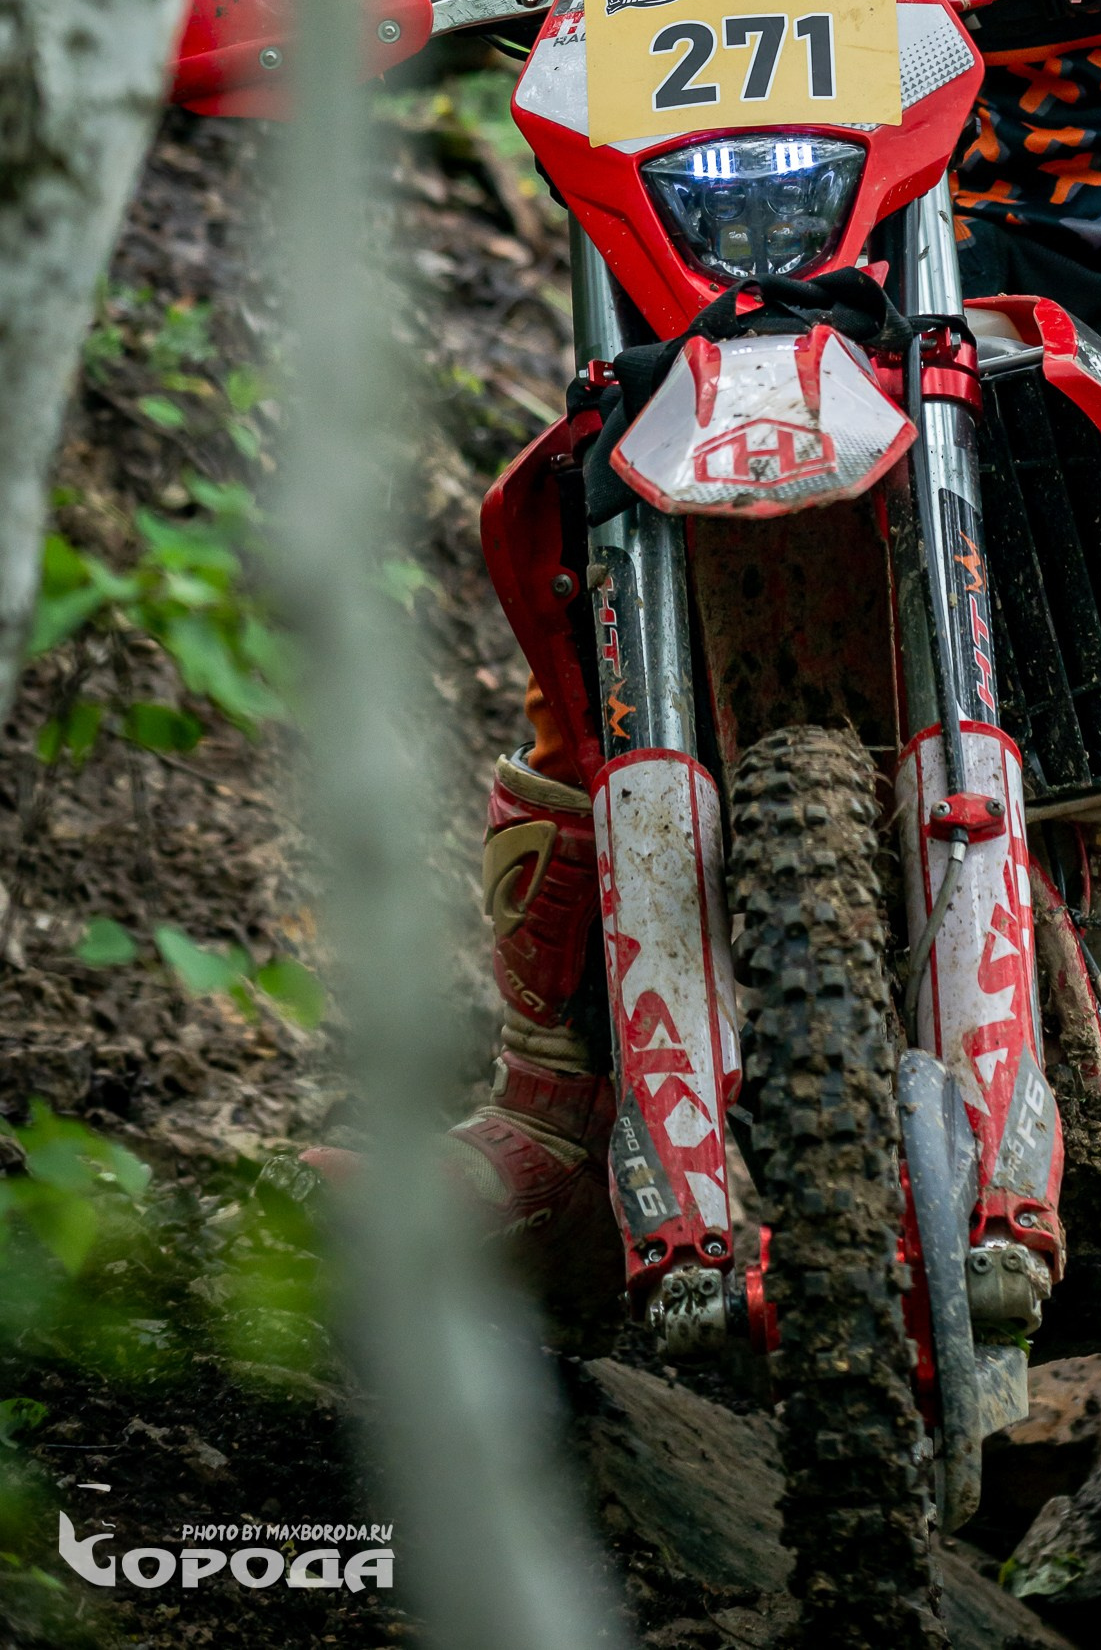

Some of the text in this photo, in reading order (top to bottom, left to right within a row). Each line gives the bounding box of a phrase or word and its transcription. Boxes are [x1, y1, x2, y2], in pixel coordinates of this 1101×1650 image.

[650, 13, 835, 111] 271
[619, 1116, 641, 1152] PRO
[1017, 1072, 1045, 1149] F6
